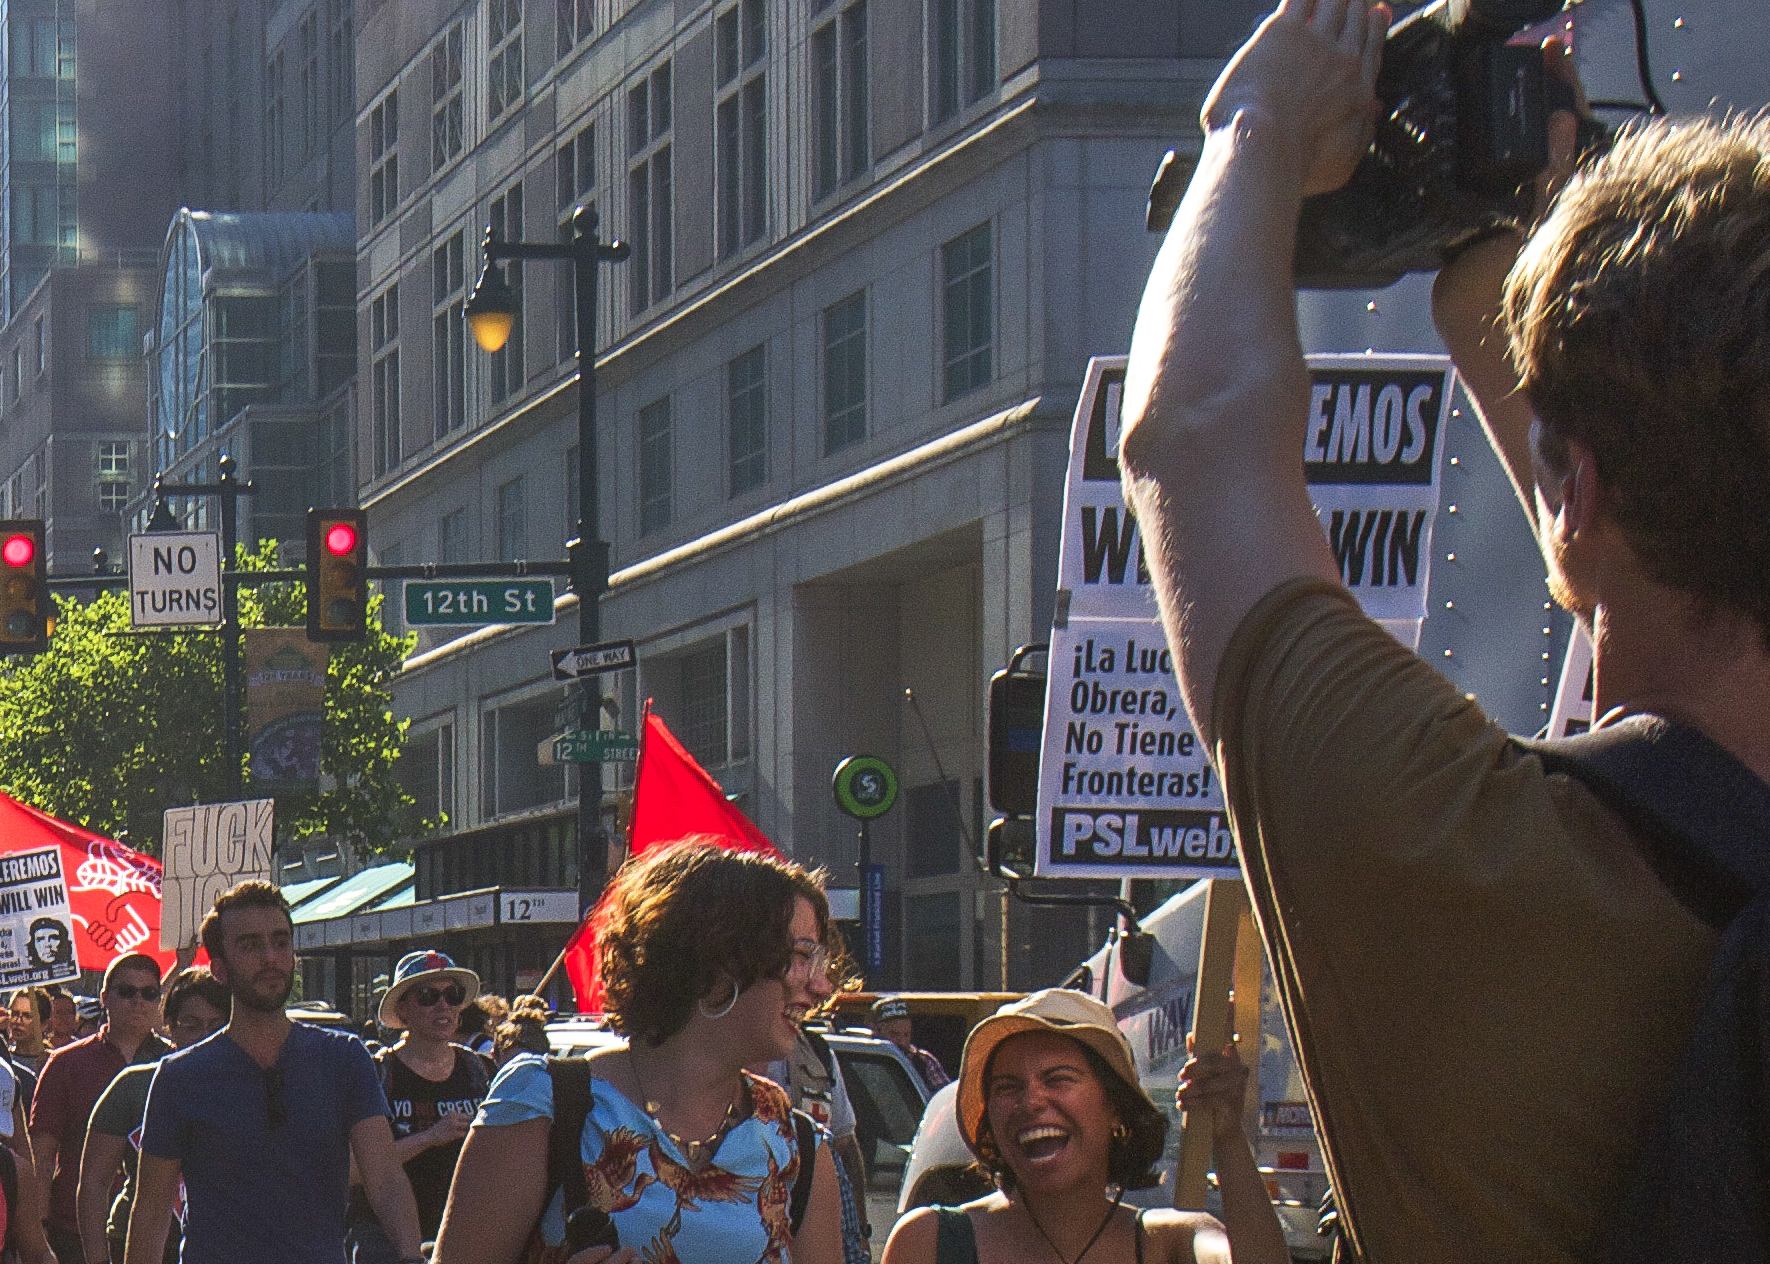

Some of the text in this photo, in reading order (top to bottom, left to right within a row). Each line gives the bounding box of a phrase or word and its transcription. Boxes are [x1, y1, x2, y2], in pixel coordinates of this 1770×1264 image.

[152, 545, 199, 576] NO
[1329, 509, 1427, 587] WIN
[135, 587, 219, 616] TURNS
[421, 588, 537, 616] 12th St
[576, 647, 627, 669] ONE WAY
[1072, 638, 1173, 679] ¡La Luc
[1070, 680, 1177, 721] Obrera,
[1064, 720, 1196, 757] No Tiene
[1061, 761, 1214, 798] Fronteras!
[164, 800, 273, 879] FUCK
[33, 884, 66, 909] WIN
[393, 1099, 413, 1117] YO
